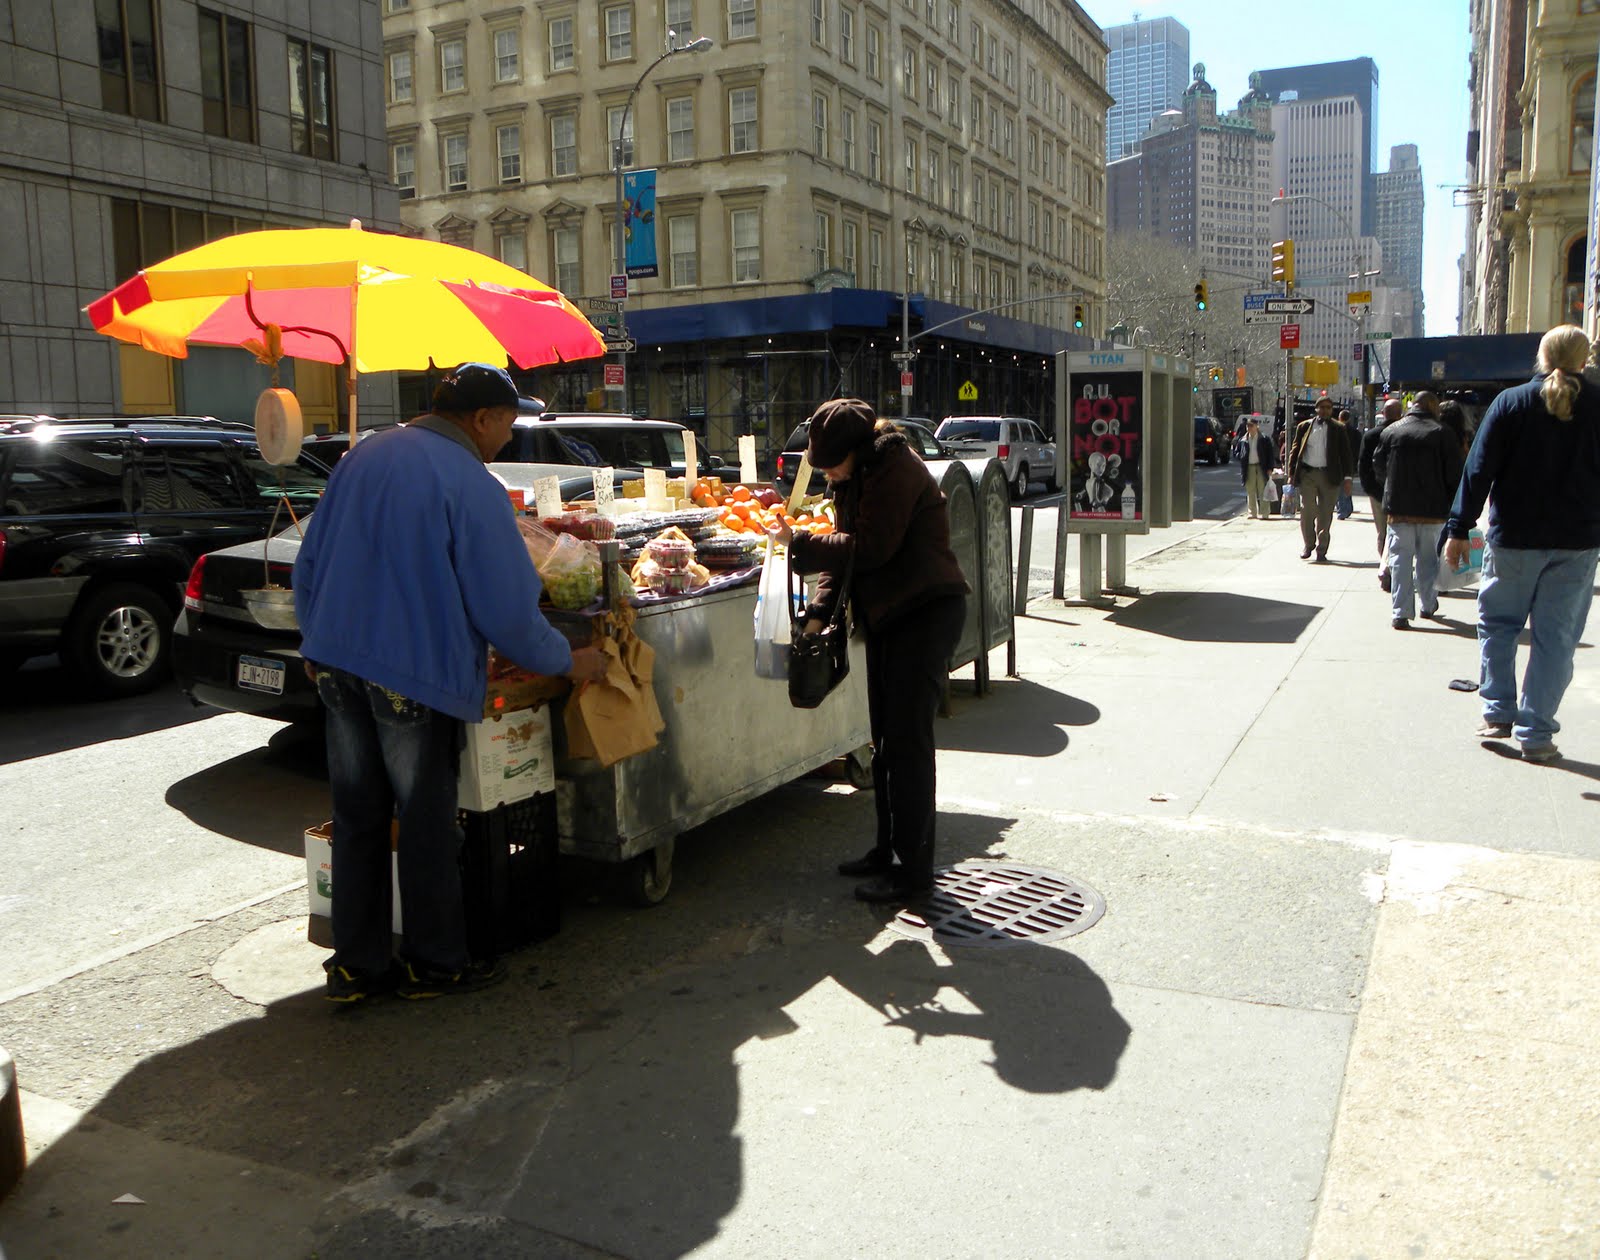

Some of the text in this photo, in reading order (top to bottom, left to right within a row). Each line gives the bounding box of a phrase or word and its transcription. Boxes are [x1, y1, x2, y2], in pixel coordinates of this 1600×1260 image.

[591, 300, 617, 312] BROADWAY
[1088, 354, 1124, 365] TITAN
[1074, 396, 1137, 424] BOT
[1091, 418, 1120, 436] OR
[1074, 433, 1137, 459] NOT
